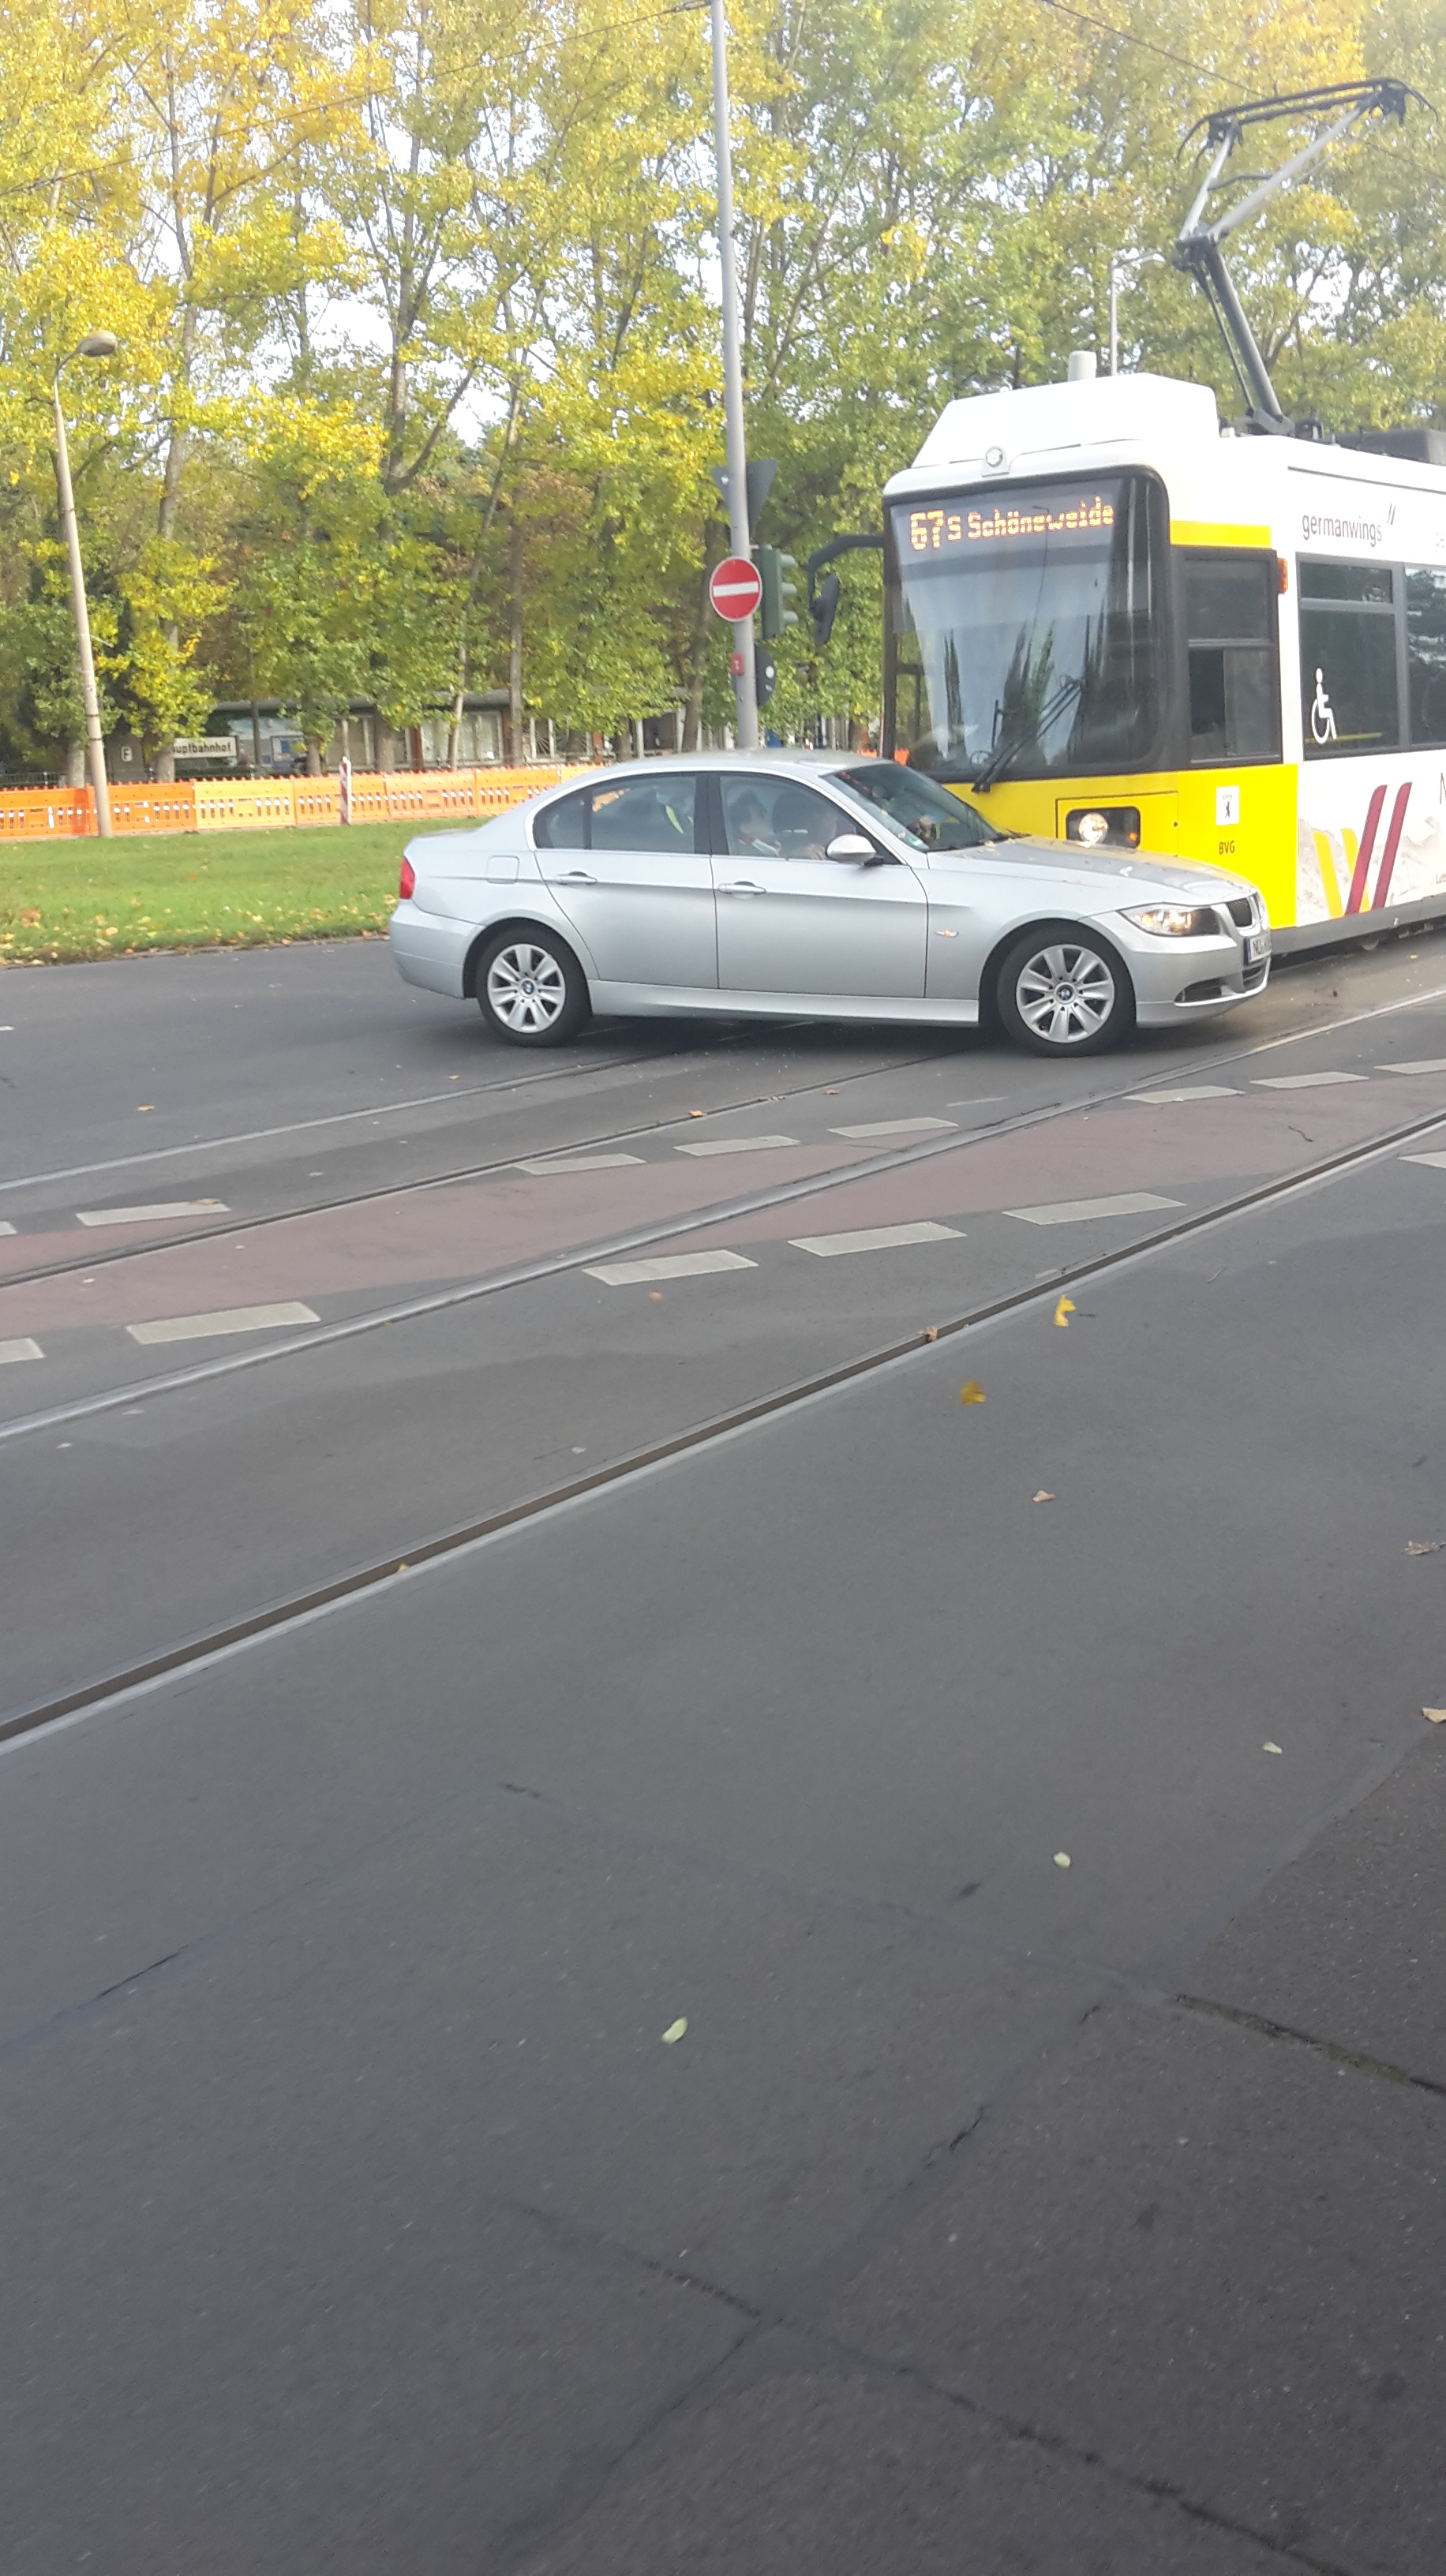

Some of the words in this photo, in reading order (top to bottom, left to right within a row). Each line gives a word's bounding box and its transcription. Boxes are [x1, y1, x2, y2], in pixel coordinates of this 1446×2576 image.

[910, 509, 944, 550] 67
[967, 495, 1114, 540] Schöneweide
[1302, 514, 1382, 548] germanwings
[173, 741, 231, 754] auptbahnhof
[1219, 840, 1235, 855] BVG
